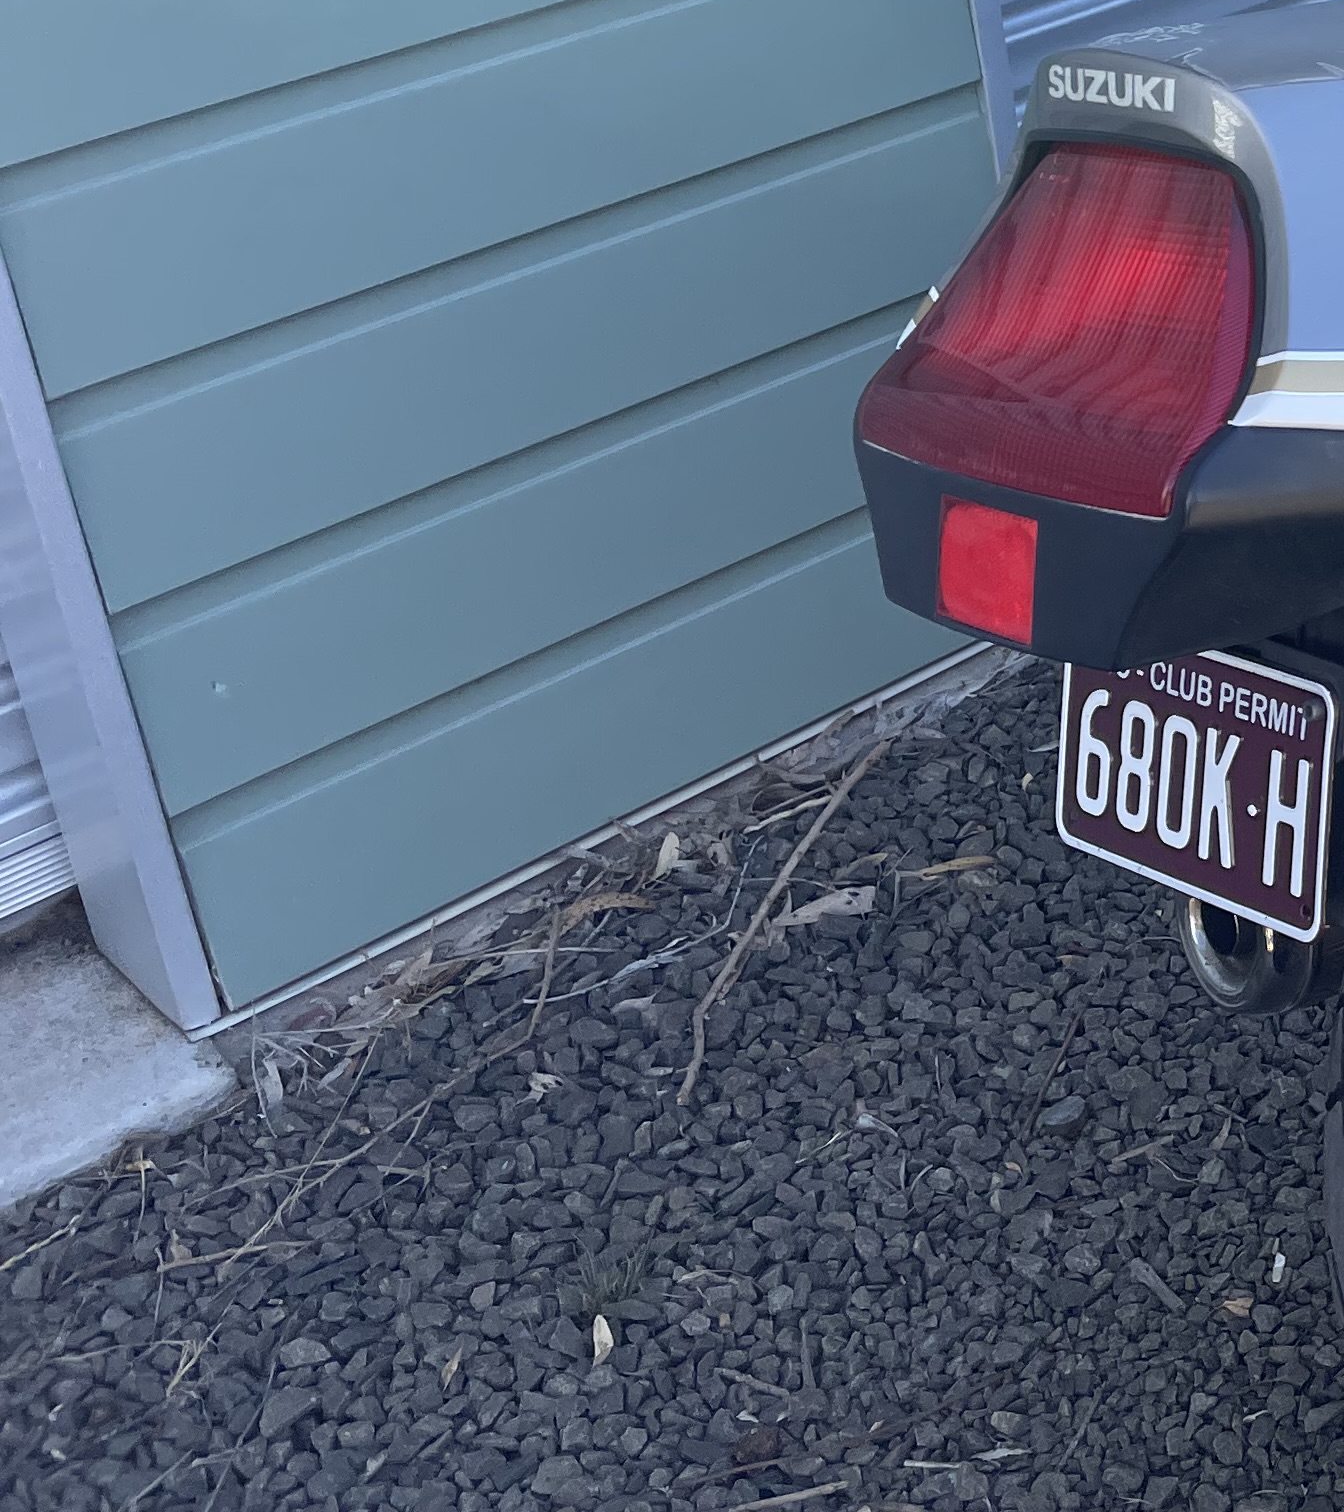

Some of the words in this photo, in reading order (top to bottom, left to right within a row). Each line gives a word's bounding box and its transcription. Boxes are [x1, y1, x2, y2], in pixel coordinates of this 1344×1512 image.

[1048, 64, 1176, 113] SUZUKI
[1149, 661, 1212, 707] CLUB
[1218, 682, 1308, 741] PERMIT
